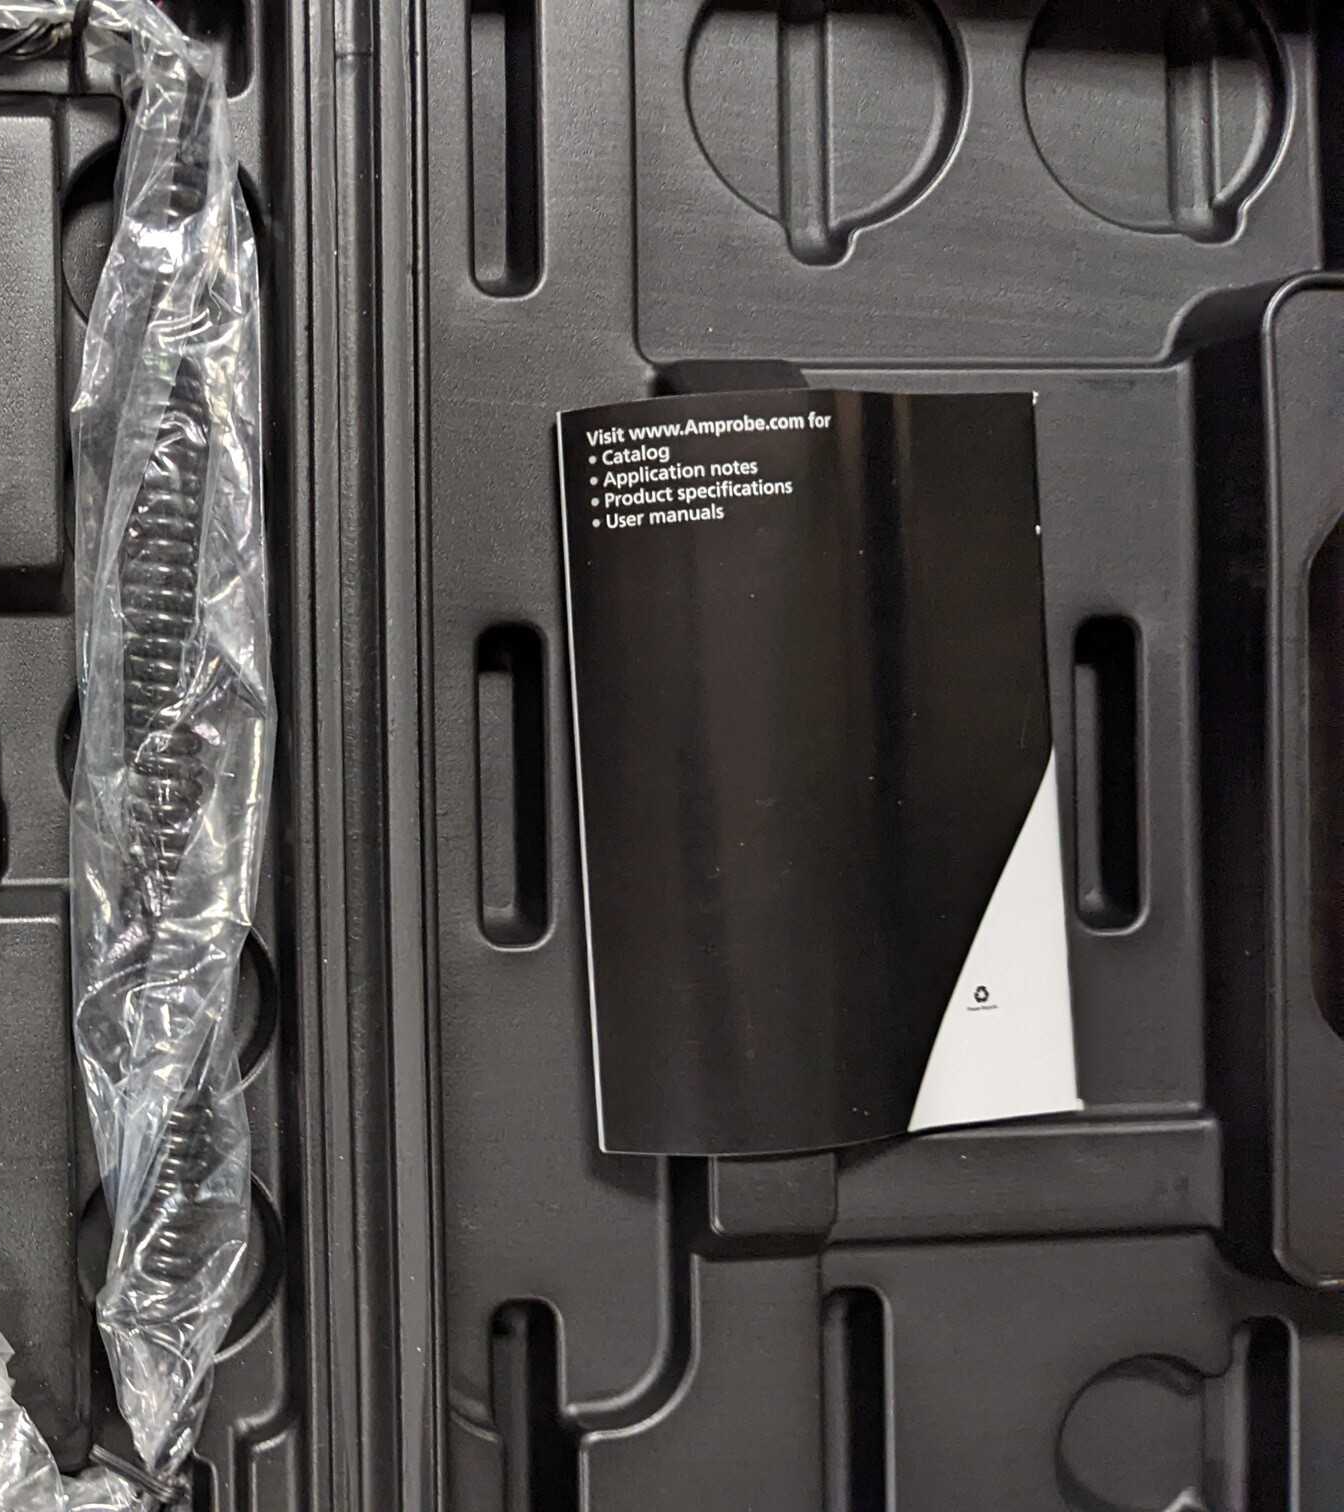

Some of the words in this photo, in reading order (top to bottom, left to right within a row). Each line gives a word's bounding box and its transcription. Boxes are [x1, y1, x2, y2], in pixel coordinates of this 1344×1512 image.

[586, 428, 625, 447] Visit
[629, 414, 805, 439] www.Amprobe.com
[808, 411, 832, 429] for
[602, 445, 671, 466] Catalog
[603, 463, 705, 489] Application
[710, 460, 758, 477] notes
[604, 489, 673, 508] Product
[677, 479, 794, 504] specifications
[606, 511, 644, 529] User
[649, 504, 725, 526] manuals
